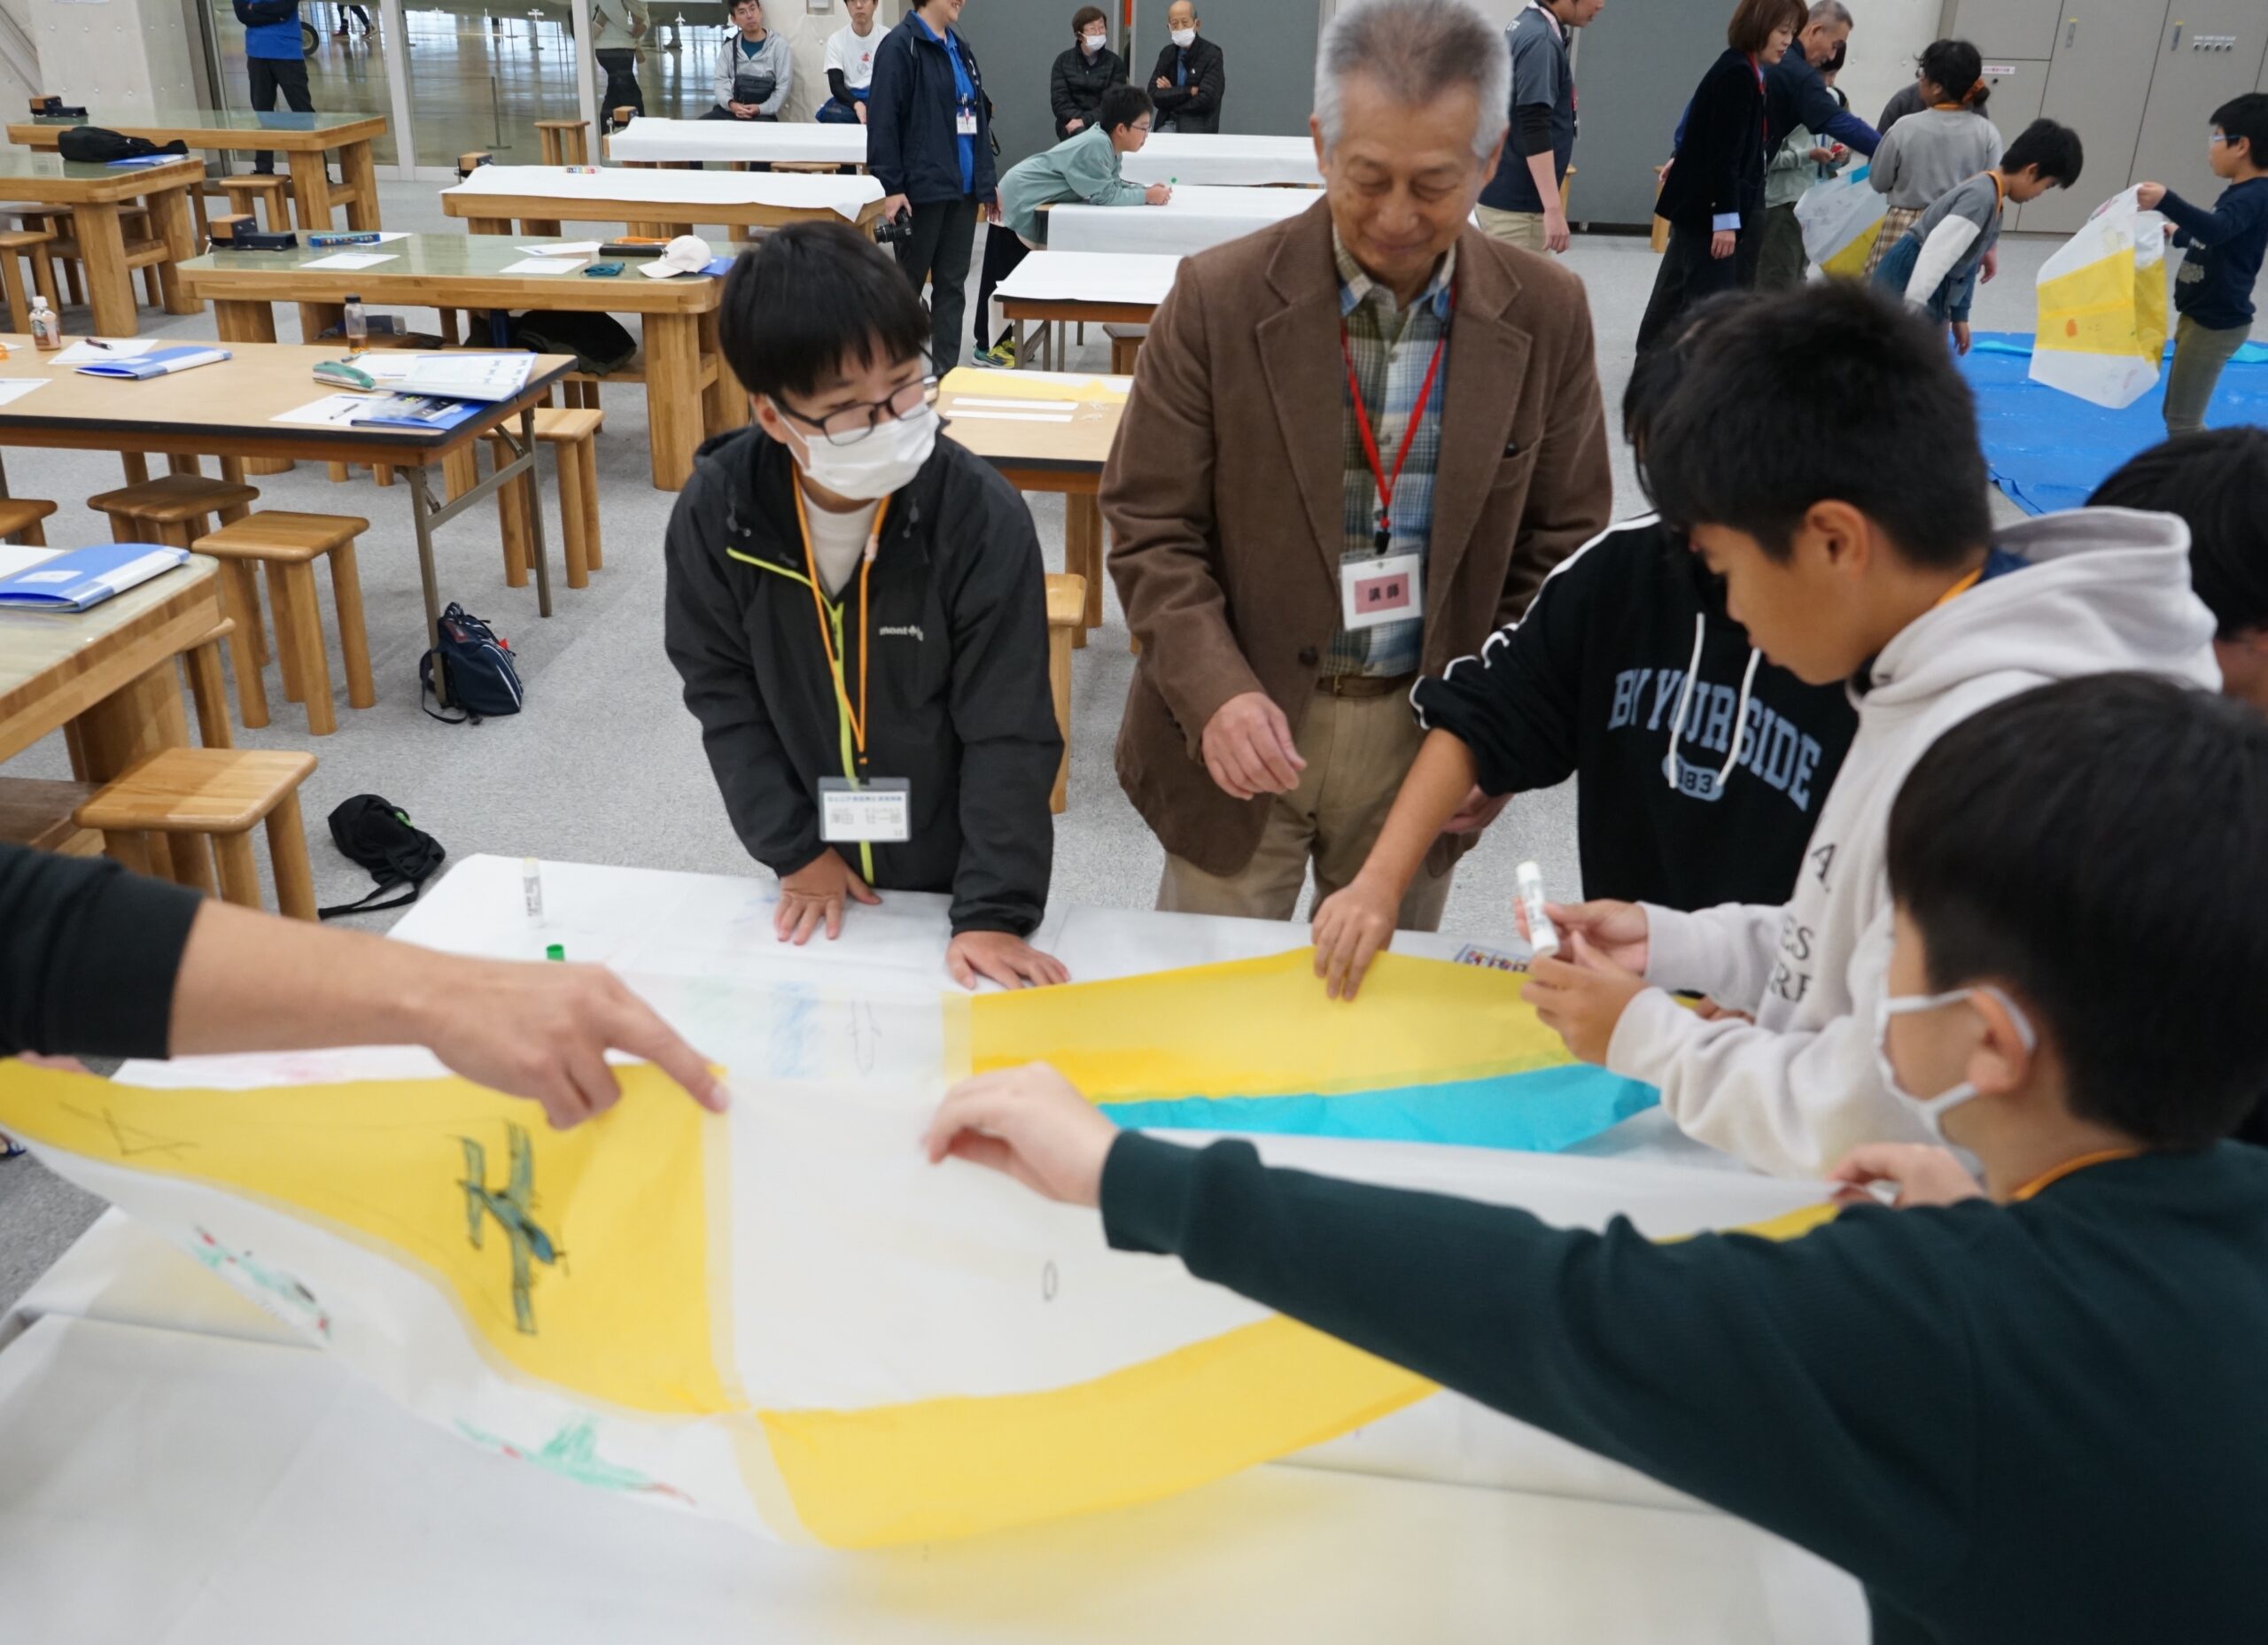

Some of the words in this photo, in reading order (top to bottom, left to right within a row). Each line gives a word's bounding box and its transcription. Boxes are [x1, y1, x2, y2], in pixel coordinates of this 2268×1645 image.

[1607, 668, 1653, 731] BY
[1646, 669, 1736, 754] YOUR
[1736, 696, 1822, 812] SIDE
